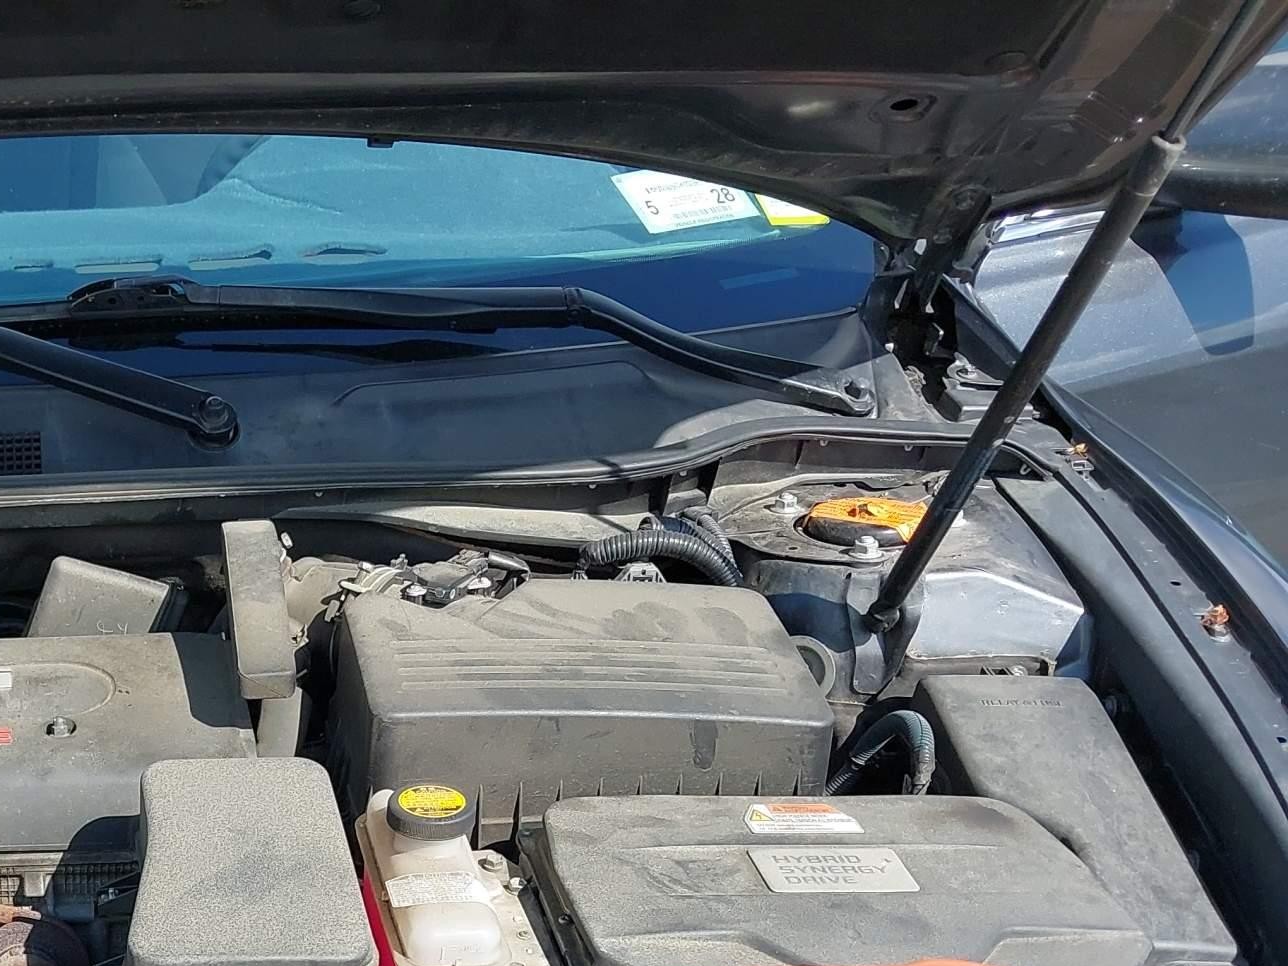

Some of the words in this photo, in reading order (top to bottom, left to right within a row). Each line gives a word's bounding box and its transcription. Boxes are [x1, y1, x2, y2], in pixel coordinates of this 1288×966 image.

[710, 188, 735, 204] 28
[645, 201, 659, 215] 5
[772, 855, 861, 864] HYBRID
[779, 865, 886, 874] SYNERGY
[785, 875, 858, 885] DRIVE
